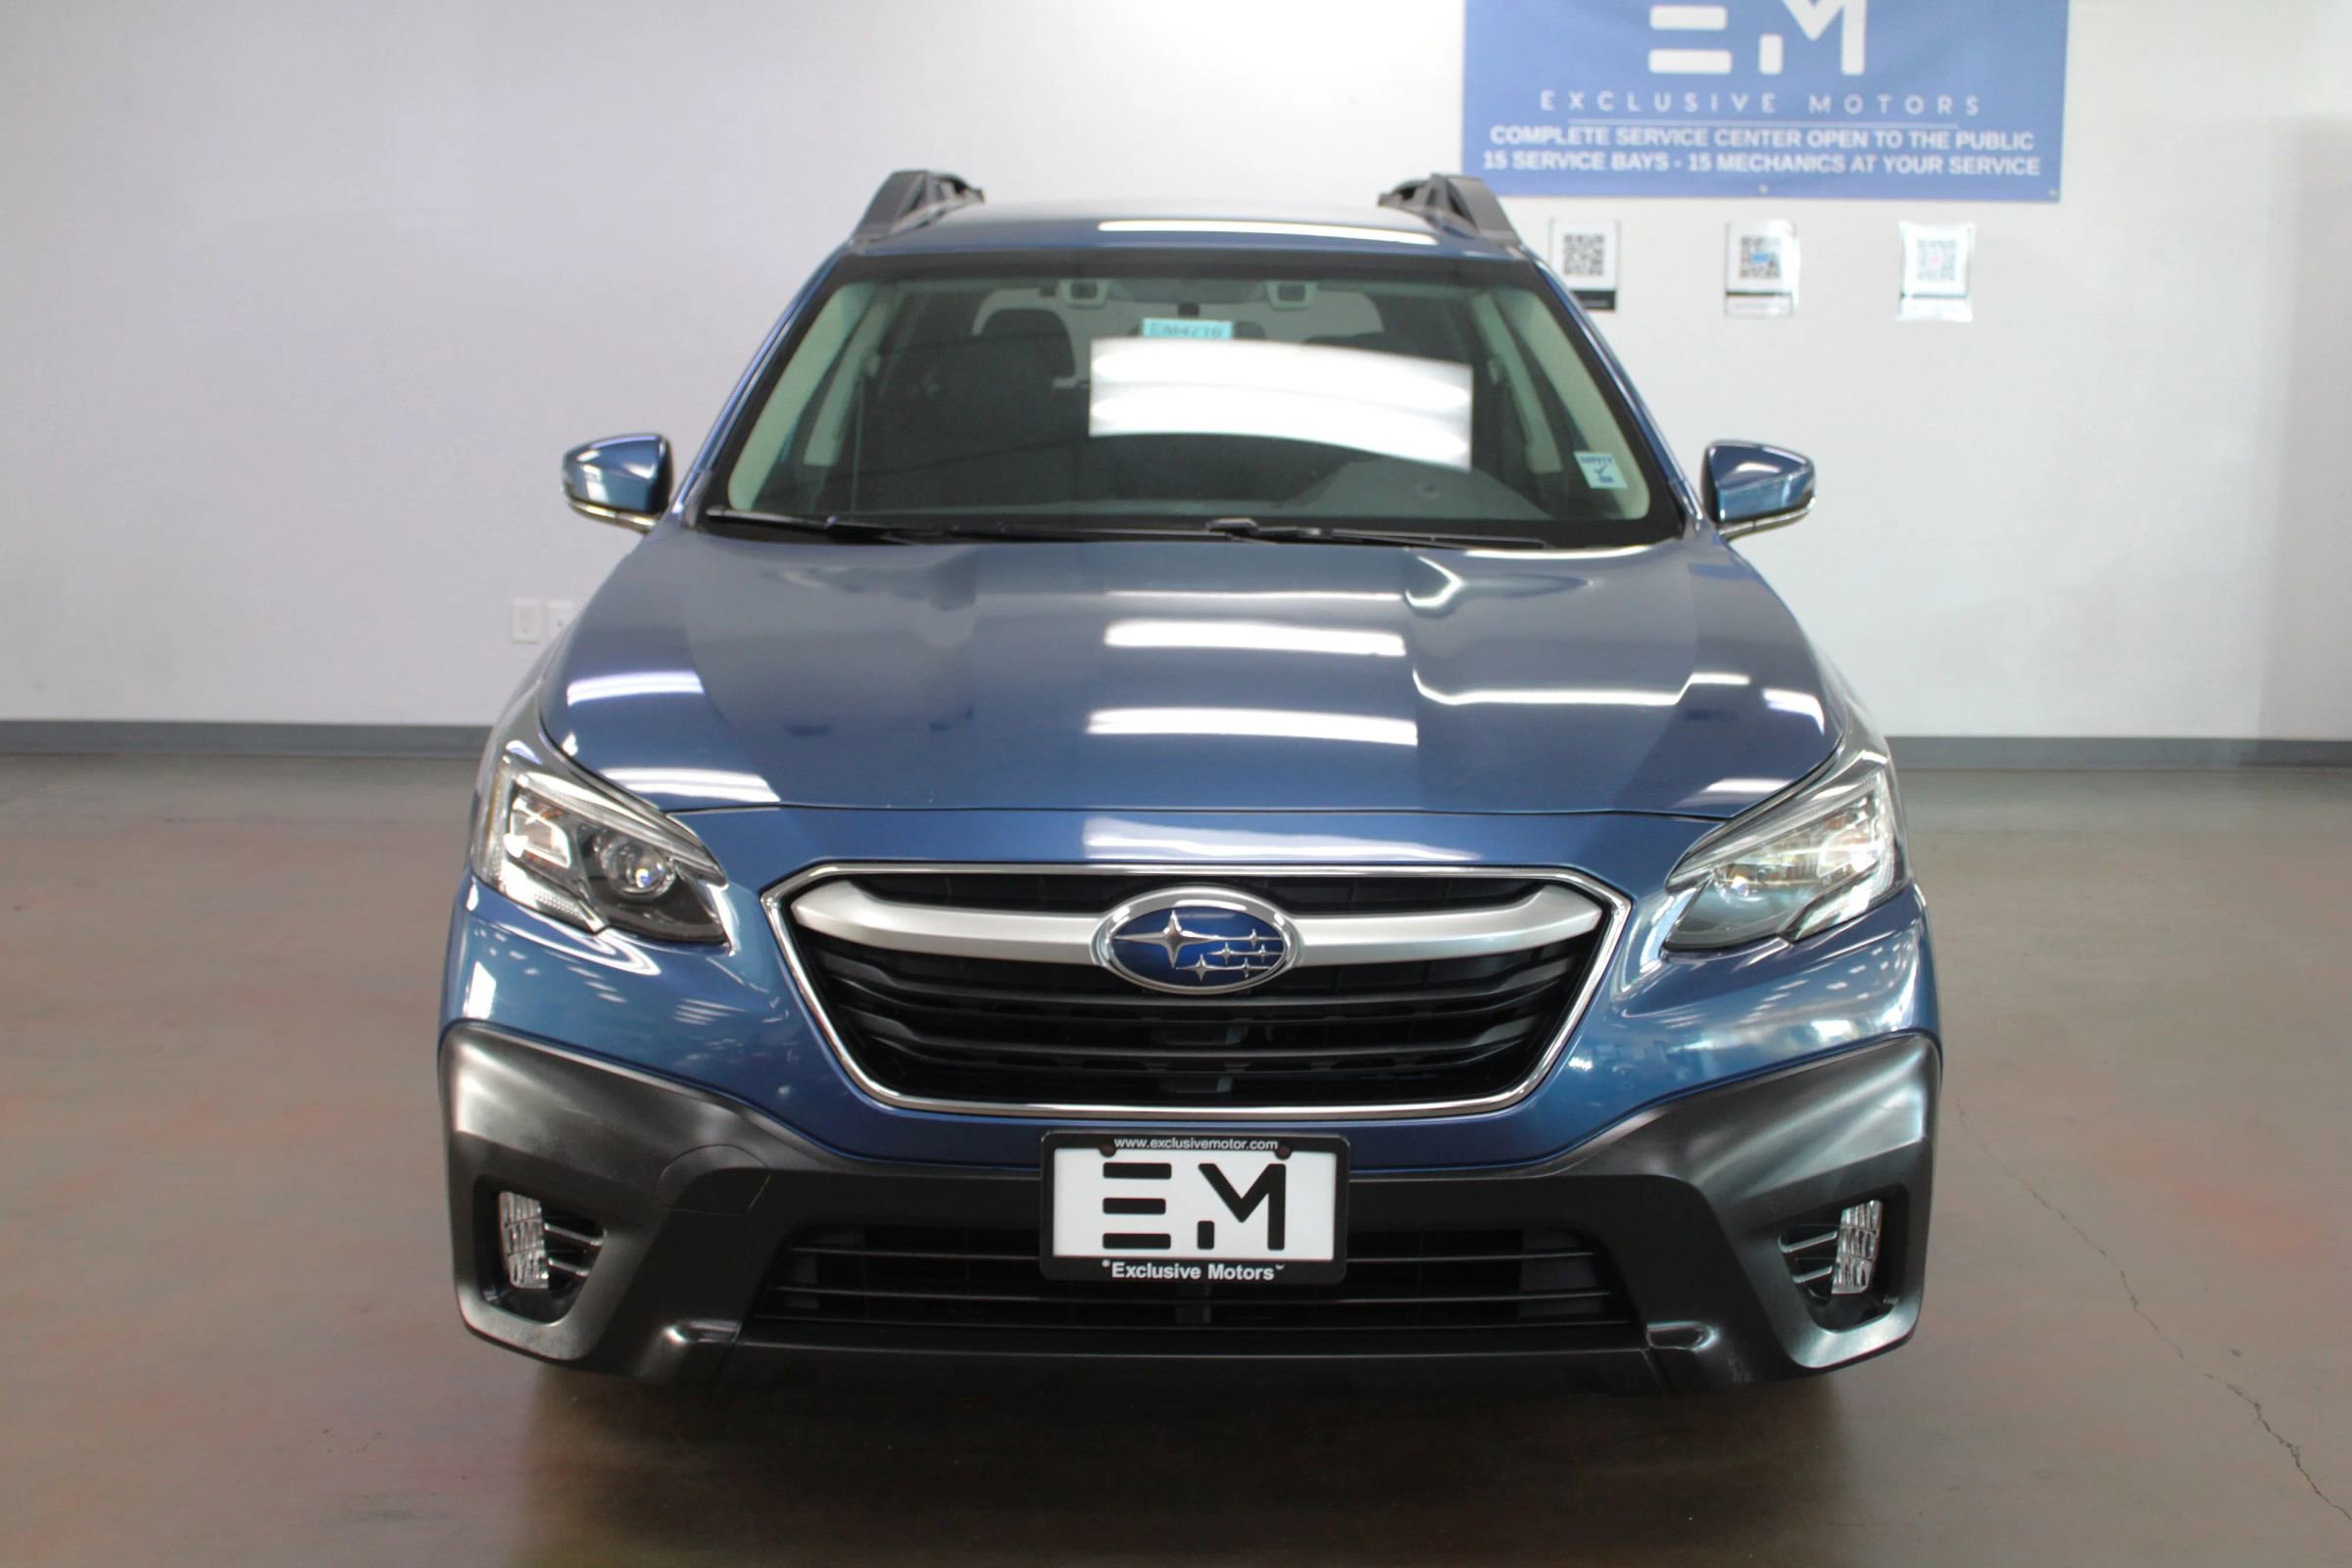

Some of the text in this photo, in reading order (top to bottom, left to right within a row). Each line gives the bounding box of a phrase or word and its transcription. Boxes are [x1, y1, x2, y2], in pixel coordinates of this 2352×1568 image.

[1541, 90, 1980, 116] EXCLUSIVE MOTORS
[1490, 124, 2035, 152] COMPLETE SERVICE CENTER OPEN TO THE PUBLIC
[1483, 150, 1507, 171] 15
[1512, 150, 1606, 172] SERVICE
[1611, 151, 1669, 172] BAYS
[1688, 153, 1712, 172] 15
[1717, 153, 1846, 173] MECHANICS
[1850, 155, 1877, 174] AT
[1883, 156, 1943, 175] YOUR
[1949, 156, 2041, 177] SERVICE
[1113, 1137, 1279, 1151] www.exclusivemotor.com
[1111, 1261, 1274, 1281] Exclusive Motors
